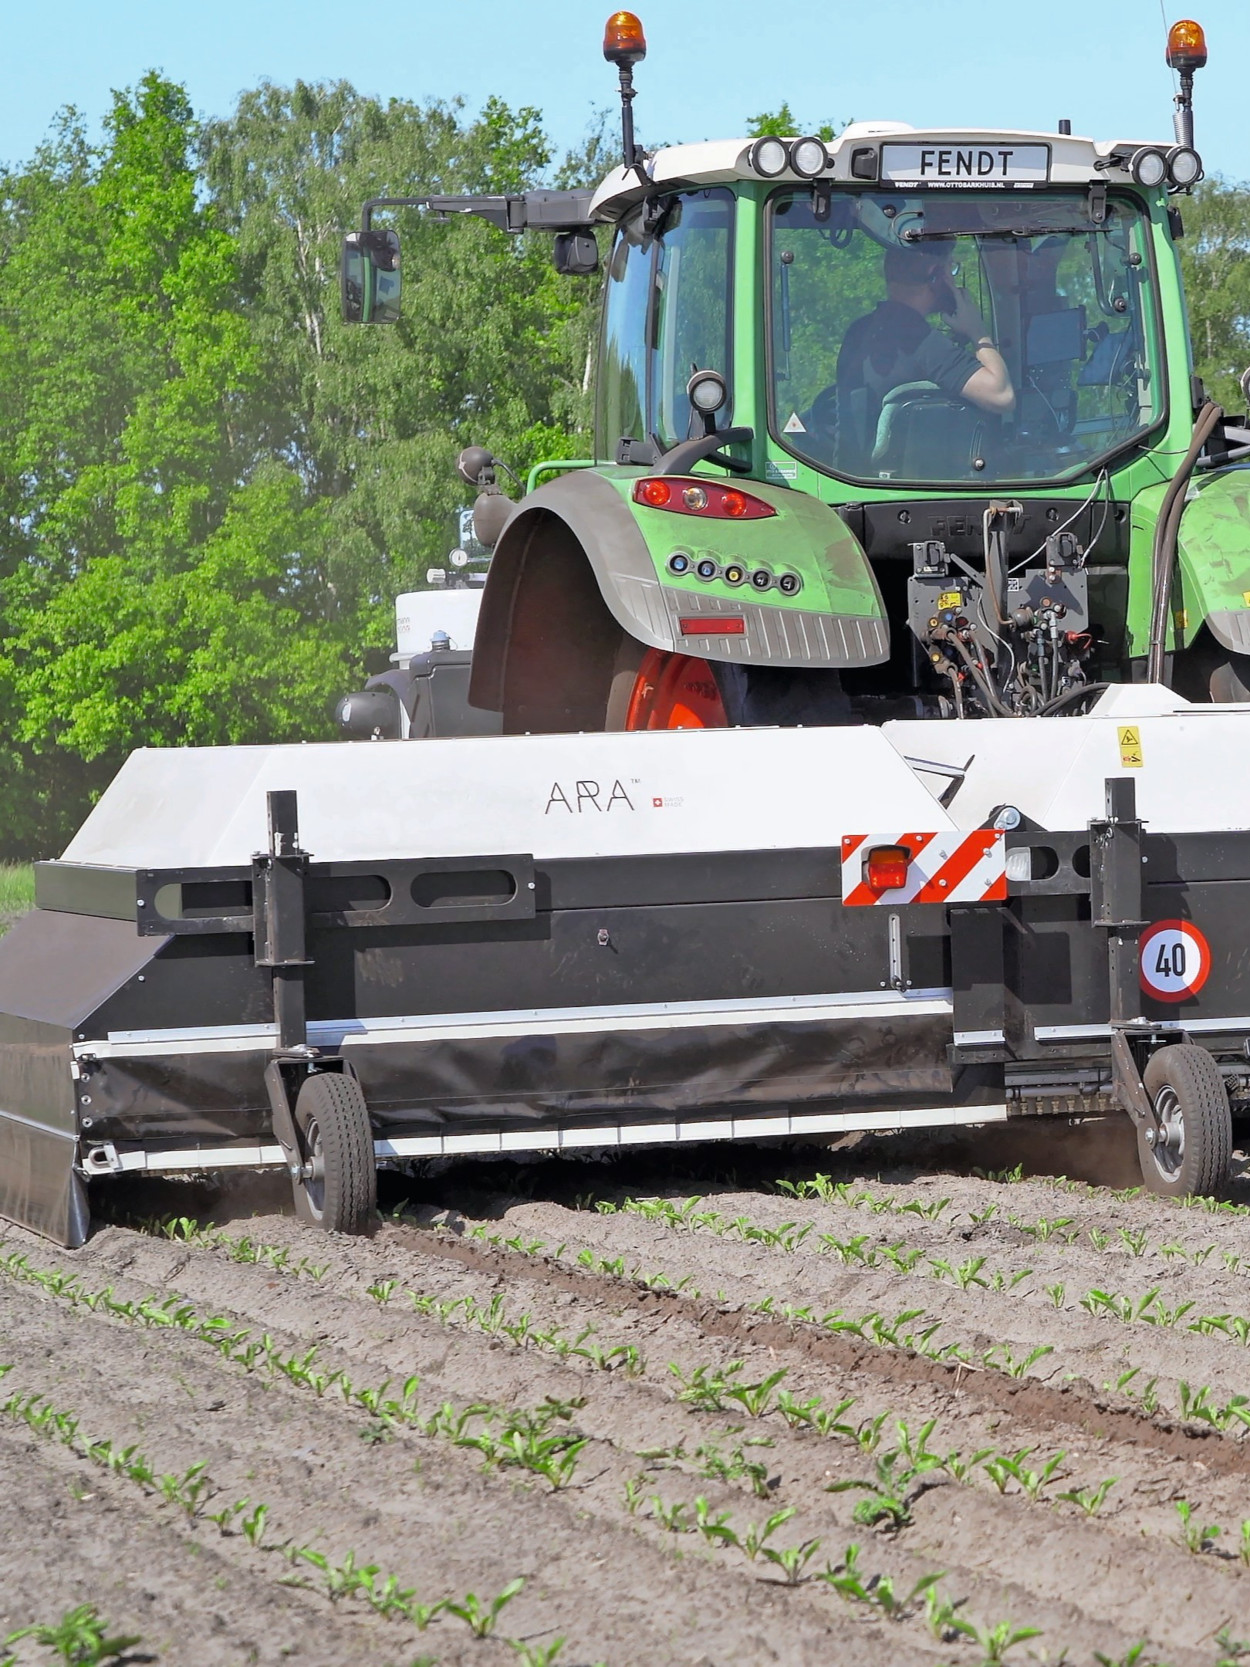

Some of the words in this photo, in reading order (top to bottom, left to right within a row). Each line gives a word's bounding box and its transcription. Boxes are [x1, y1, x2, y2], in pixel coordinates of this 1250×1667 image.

[920, 150, 1014, 176] FENDT
[545, 779, 635, 815] ARA
[1155, 943, 1186, 977] 40
